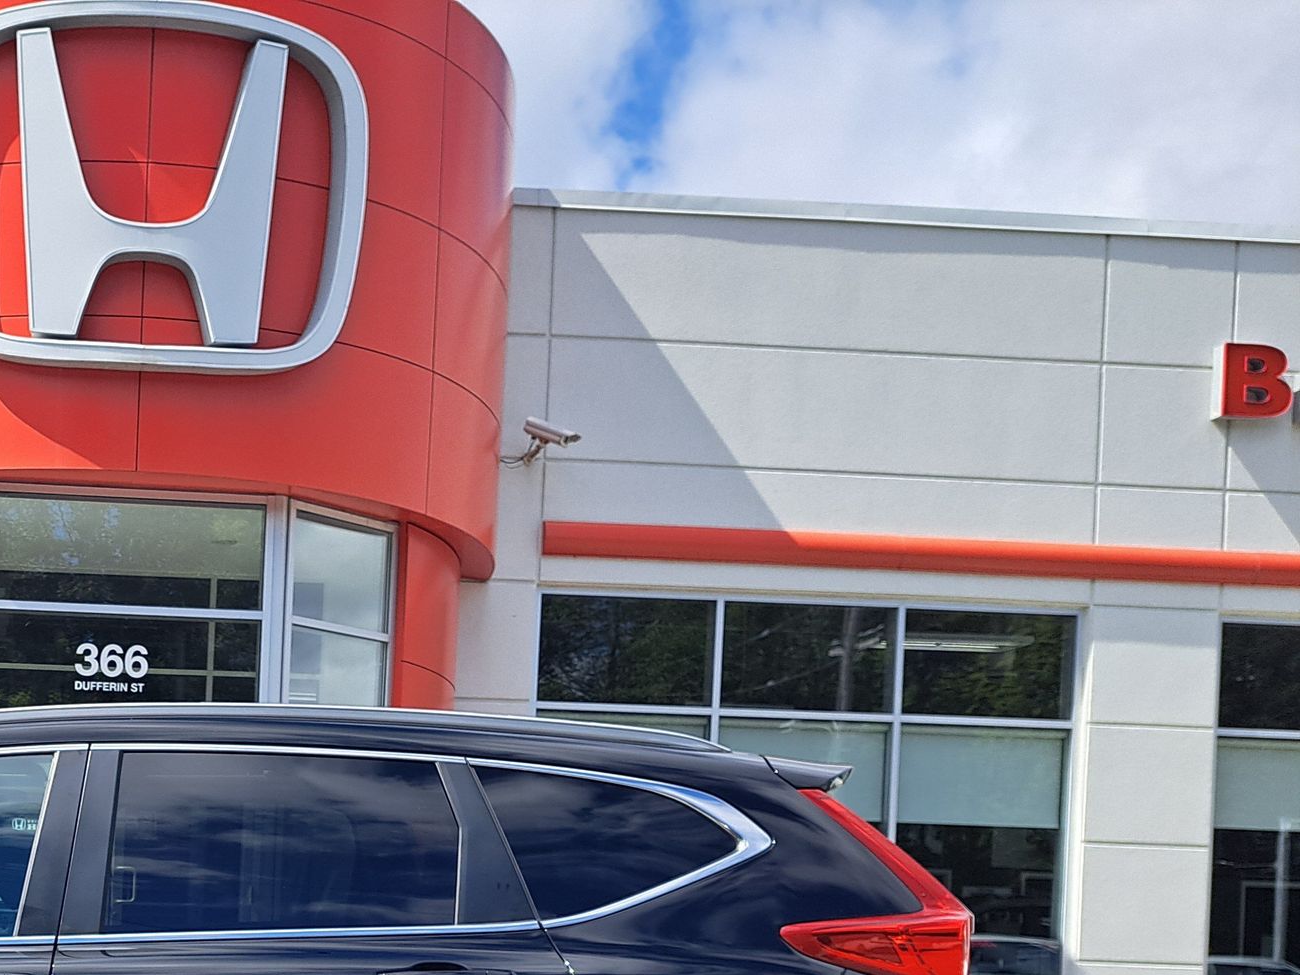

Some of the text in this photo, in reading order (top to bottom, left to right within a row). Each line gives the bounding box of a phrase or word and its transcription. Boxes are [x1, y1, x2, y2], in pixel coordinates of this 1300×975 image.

[1213, 342, 1293, 419] B
[74, 642, 149, 678] 366
[74, 680, 145, 693] DUFFERIN ST
